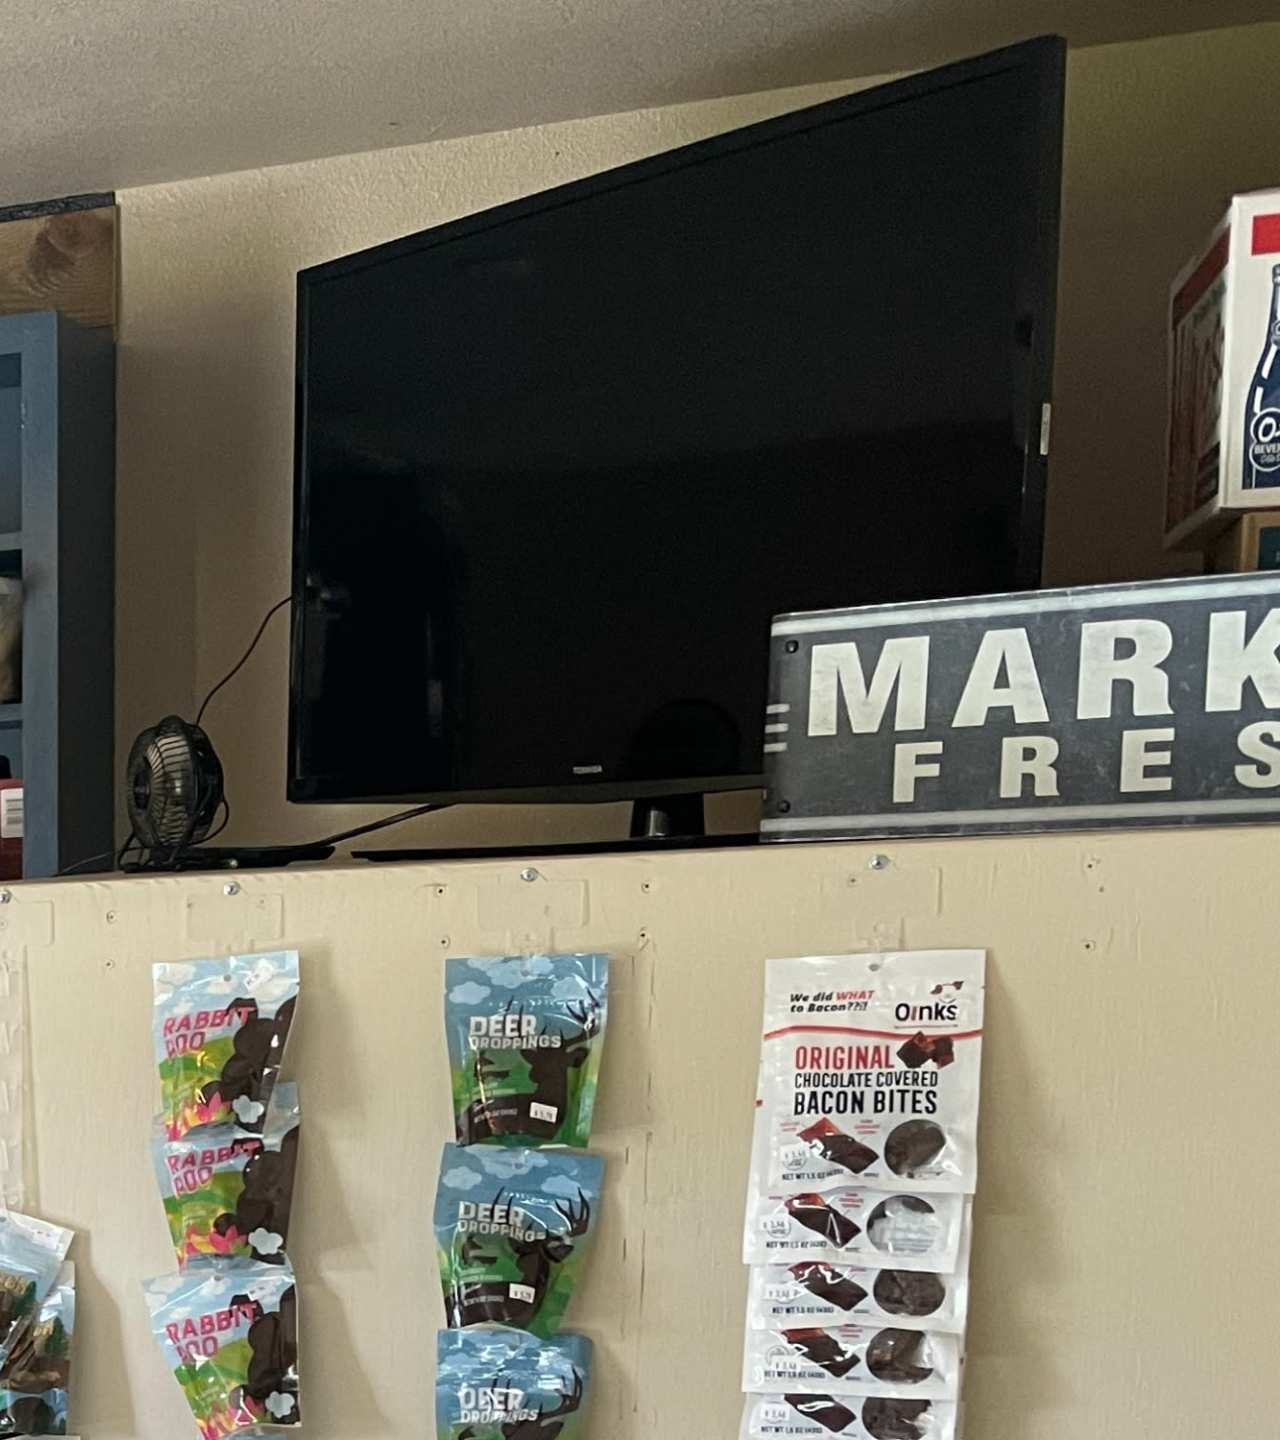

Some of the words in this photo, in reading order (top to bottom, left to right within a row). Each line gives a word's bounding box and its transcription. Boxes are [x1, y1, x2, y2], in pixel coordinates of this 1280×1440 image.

[790, 993, 810, 1003] We
[813, 991, 833, 1002] did
[836, 990, 875, 1001] WHAT
[791, 1003, 804, 1013] to
[162, 1007, 257, 1038] RABBIT
[895, 1001, 958, 1022] Oinks
[469, 1014, 537, 1037] DEER
[468, 1034, 561, 1050] DROPPINGS
[794, 1045, 895, 1070] ORIGINAL
[794, 1072, 872, 1088] CHOCOLATE
[876, 1070, 938, 1087] COVERED
[794, 1090, 864, 1115] BACON
[873, 1089, 937, 1114] BITES
[167, 1141, 261, 1175] RABBIT
[173, 1166, 213, 1196] POO
[458, 1201, 524, 1227] DEER
[166, 1303, 257, 1344] RABBIT
[459, 1387, 524, 1411] DEER
[460, 1409, 539, 1423] DROPPINGS
